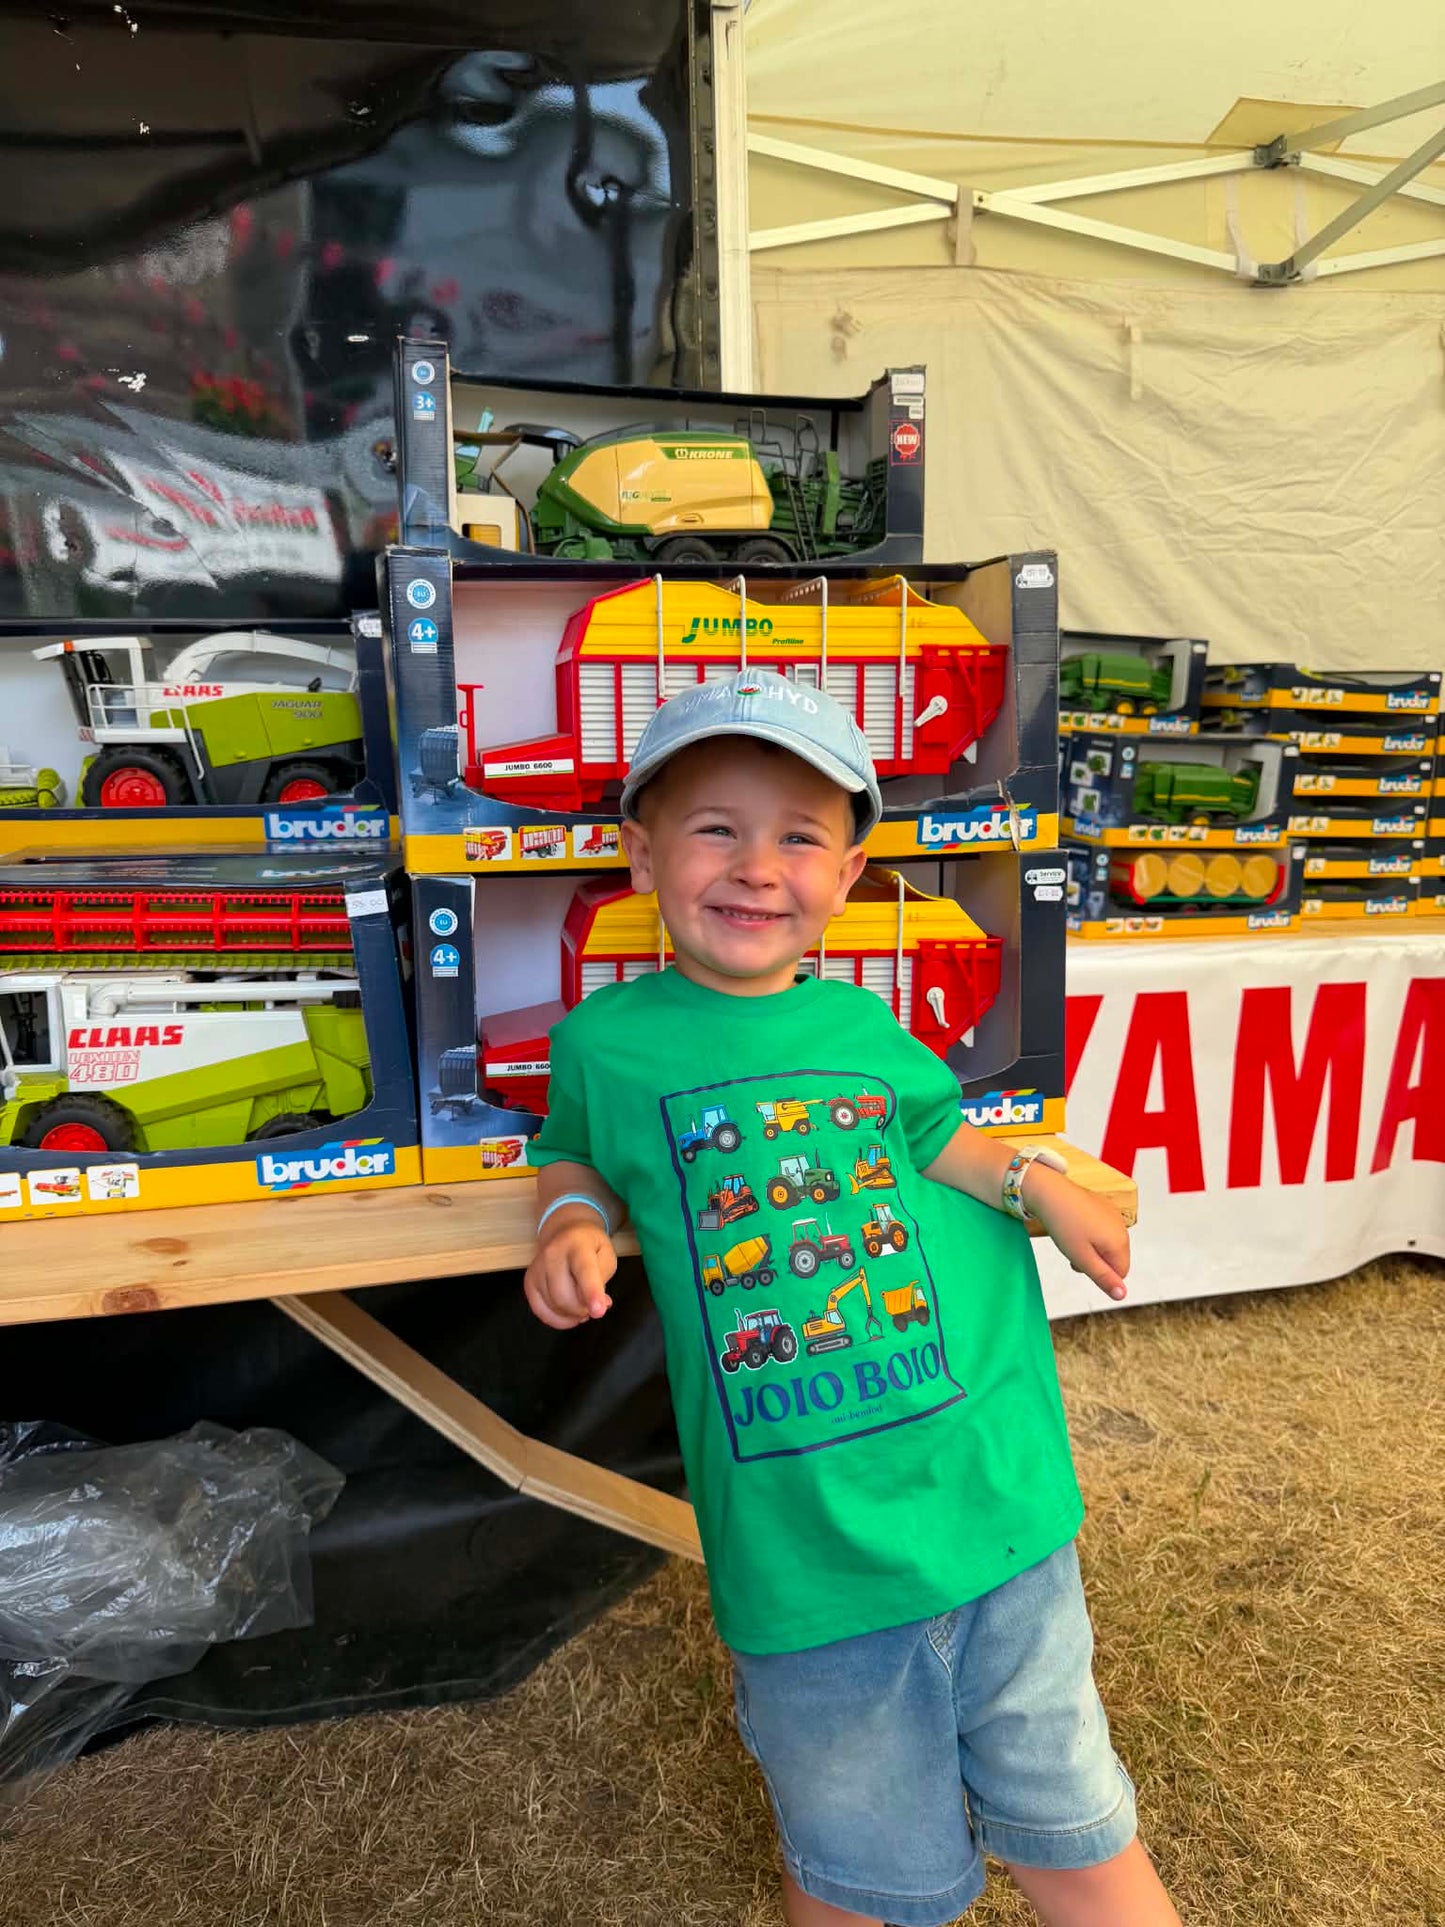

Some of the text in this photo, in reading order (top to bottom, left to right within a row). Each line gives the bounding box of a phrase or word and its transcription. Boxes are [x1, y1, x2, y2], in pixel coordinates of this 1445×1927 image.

[416, 395, 434, 410] 3+
[896, 434, 917, 445] NEW
[689, 450, 734, 460] KRONE
[411, 622, 436, 641] 4+
[681, 617, 773, 644] JUMBO
[768, 686, 819, 715] HYD
[505, 761, 553, 771] JUMBO 6600
[268, 813, 385, 839] bruder
[433, 949, 457, 965] 4+
[67, 1024, 185, 1049] CLAAS
[69, 1062, 139, 1083] 480
[507, 1063, 533, 1072] JUMBO
[961, 1098, 1039, 1126] uder
[261, 1147, 390, 1184] bruder
[734, 1341, 940, 1428] JOIO BOIO
